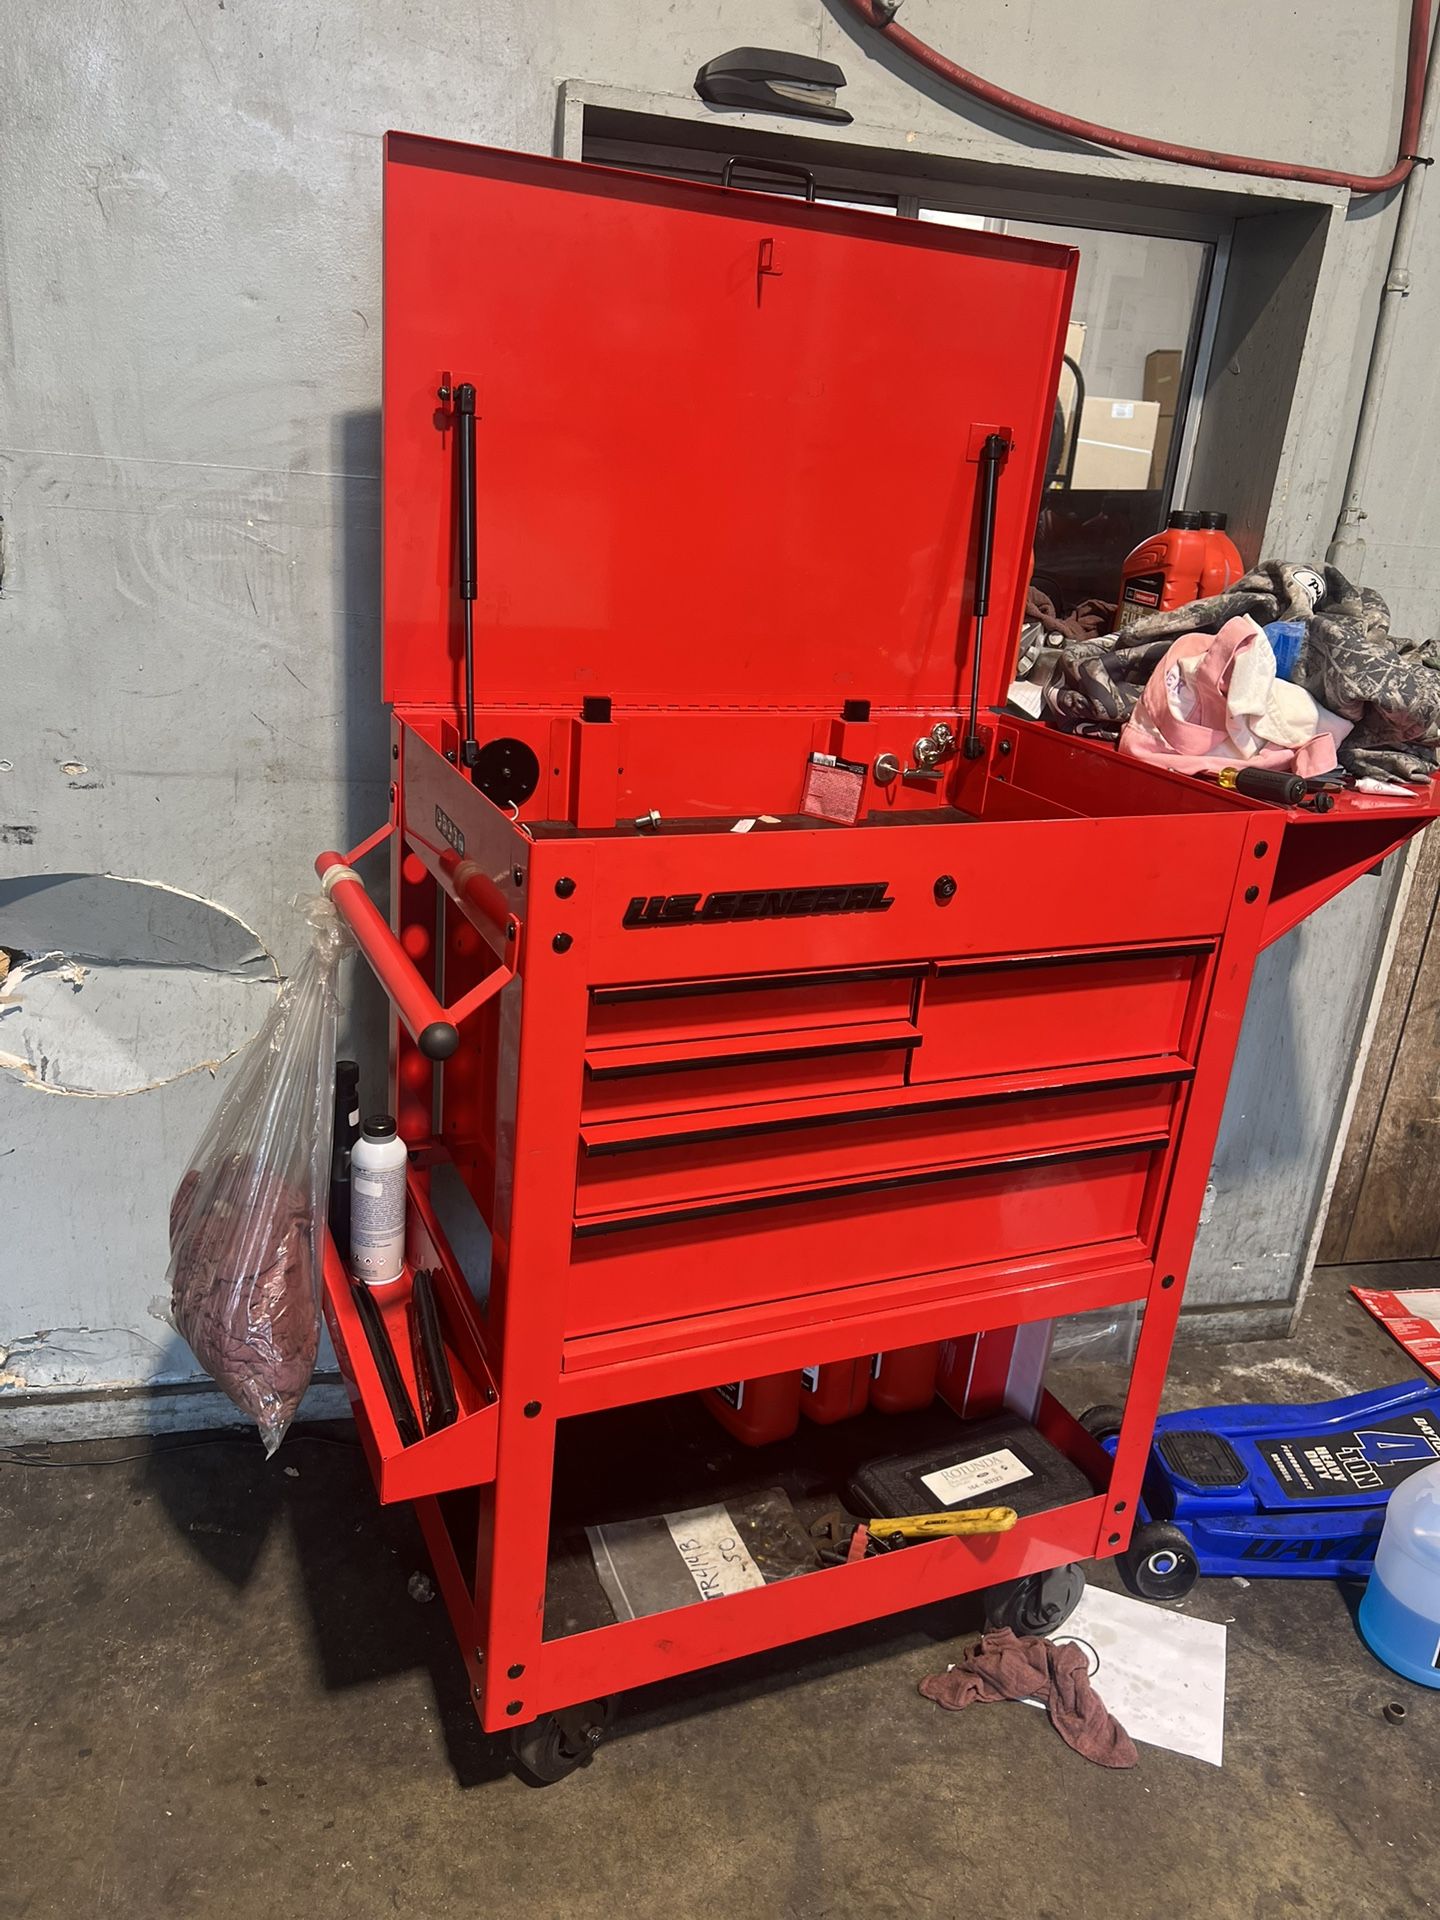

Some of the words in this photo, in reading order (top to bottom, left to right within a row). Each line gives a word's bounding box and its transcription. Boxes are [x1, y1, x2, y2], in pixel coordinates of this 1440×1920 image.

[702, 881, 895, 922] GENERAL
[1304, 1450, 1333, 1480] DUTY
[1314, 1446, 1348, 1482] HEAVY
[1353, 1430, 1440, 1467] 4
[940, 1456, 1002, 1481] ROTUNDA
[1336, 1448, 1384, 1489] TON
